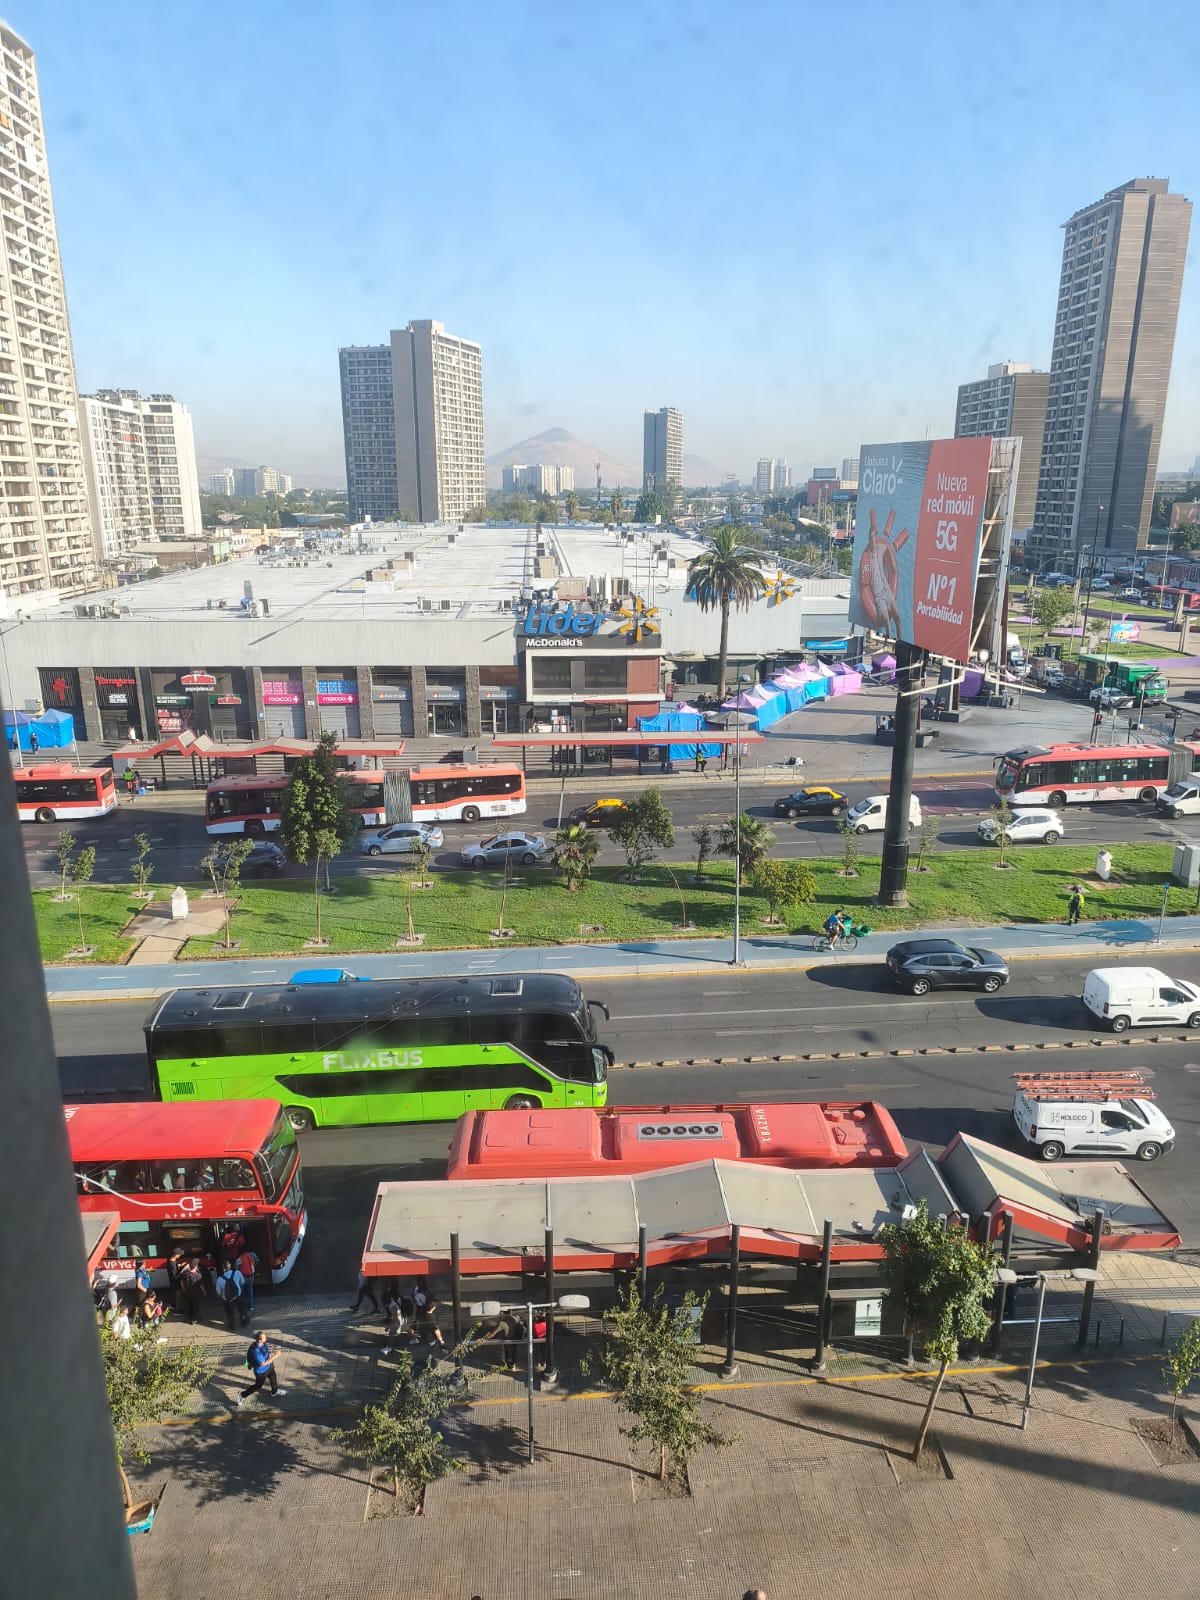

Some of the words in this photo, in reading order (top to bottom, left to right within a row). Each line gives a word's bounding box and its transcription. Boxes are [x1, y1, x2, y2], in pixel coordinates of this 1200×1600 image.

[862, 468, 896, 494] Claro
[937, 472, 967, 492] Nueva
[927, 494, 944, 512] red
[945, 494, 975, 516] móvil
[935, 520, 958, 551] 5G
[917, 601, 963, 625] Portabilidad
[526, 639, 583, 647] McDonald's
[322, 1050, 423, 1070] FLIXBUS
[103, 1261, 117, 1269] VP
[118, 1261, 132, 1269] YG
